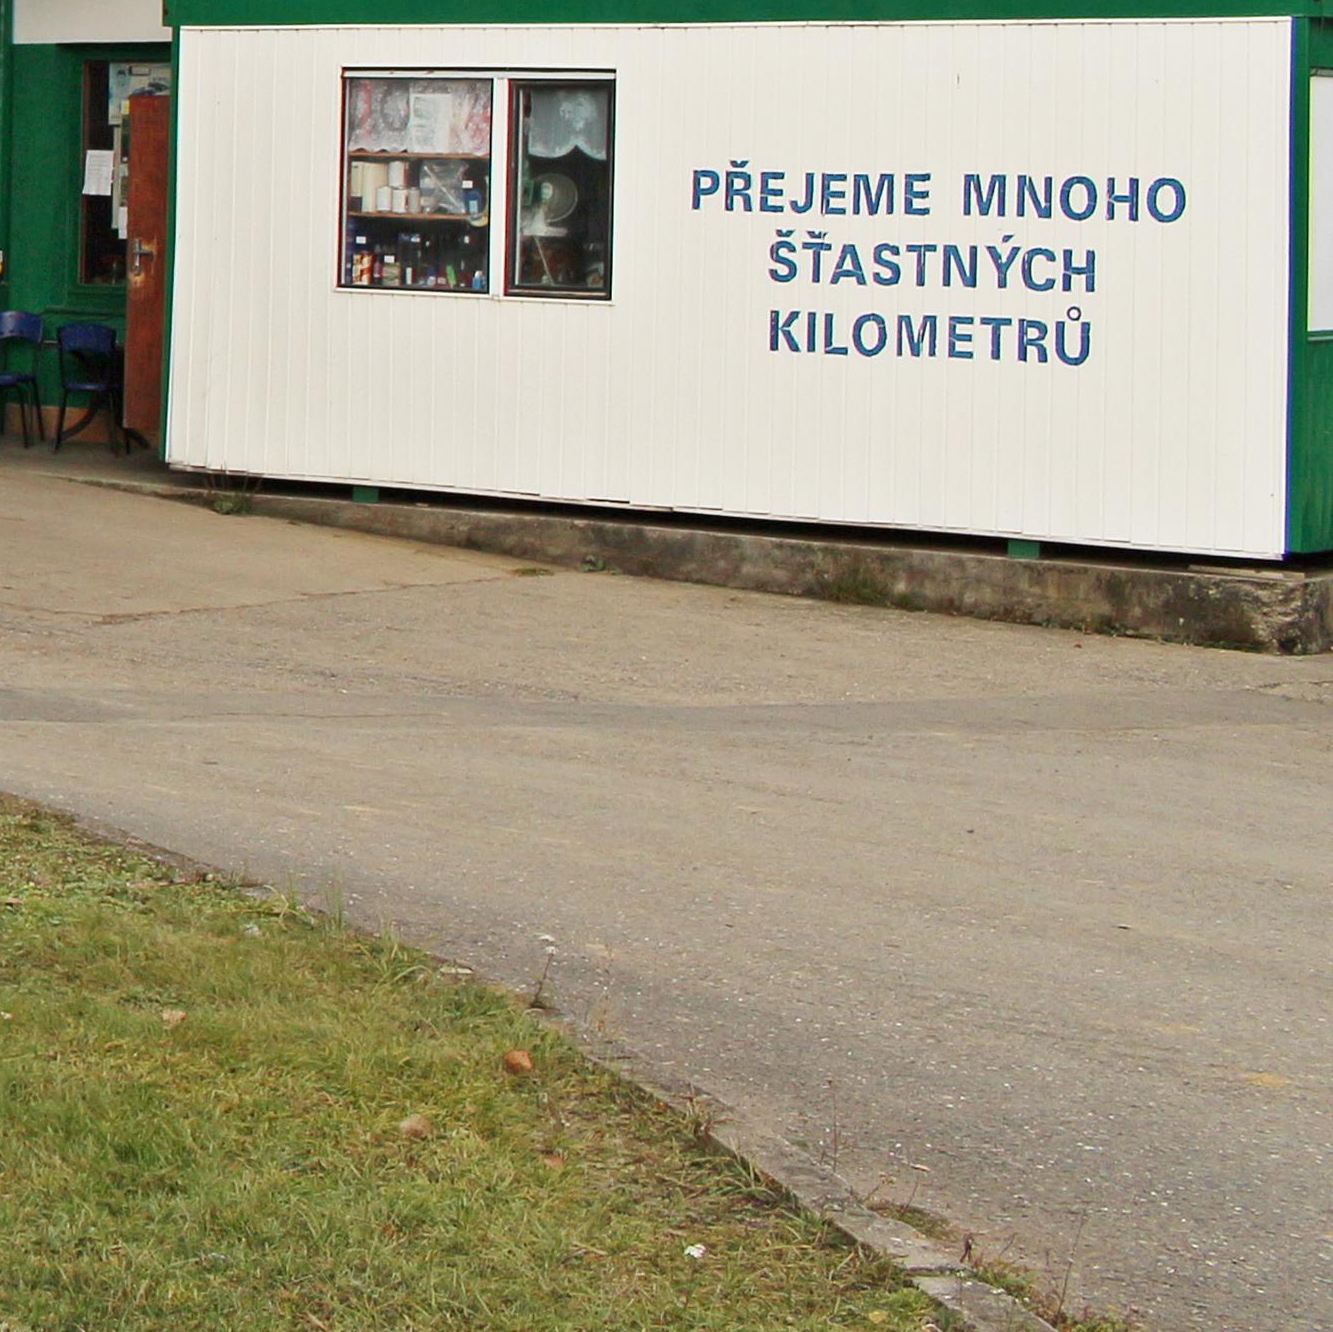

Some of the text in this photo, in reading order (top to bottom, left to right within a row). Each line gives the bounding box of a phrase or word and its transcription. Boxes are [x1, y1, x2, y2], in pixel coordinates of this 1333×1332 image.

[691, 160, 1187, 223] PŘEJEME MNOHO
[768, 229, 1097, 292] ŠŤASTNÝCH
[769, 306, 1092, 366] KILOMETRŮ
